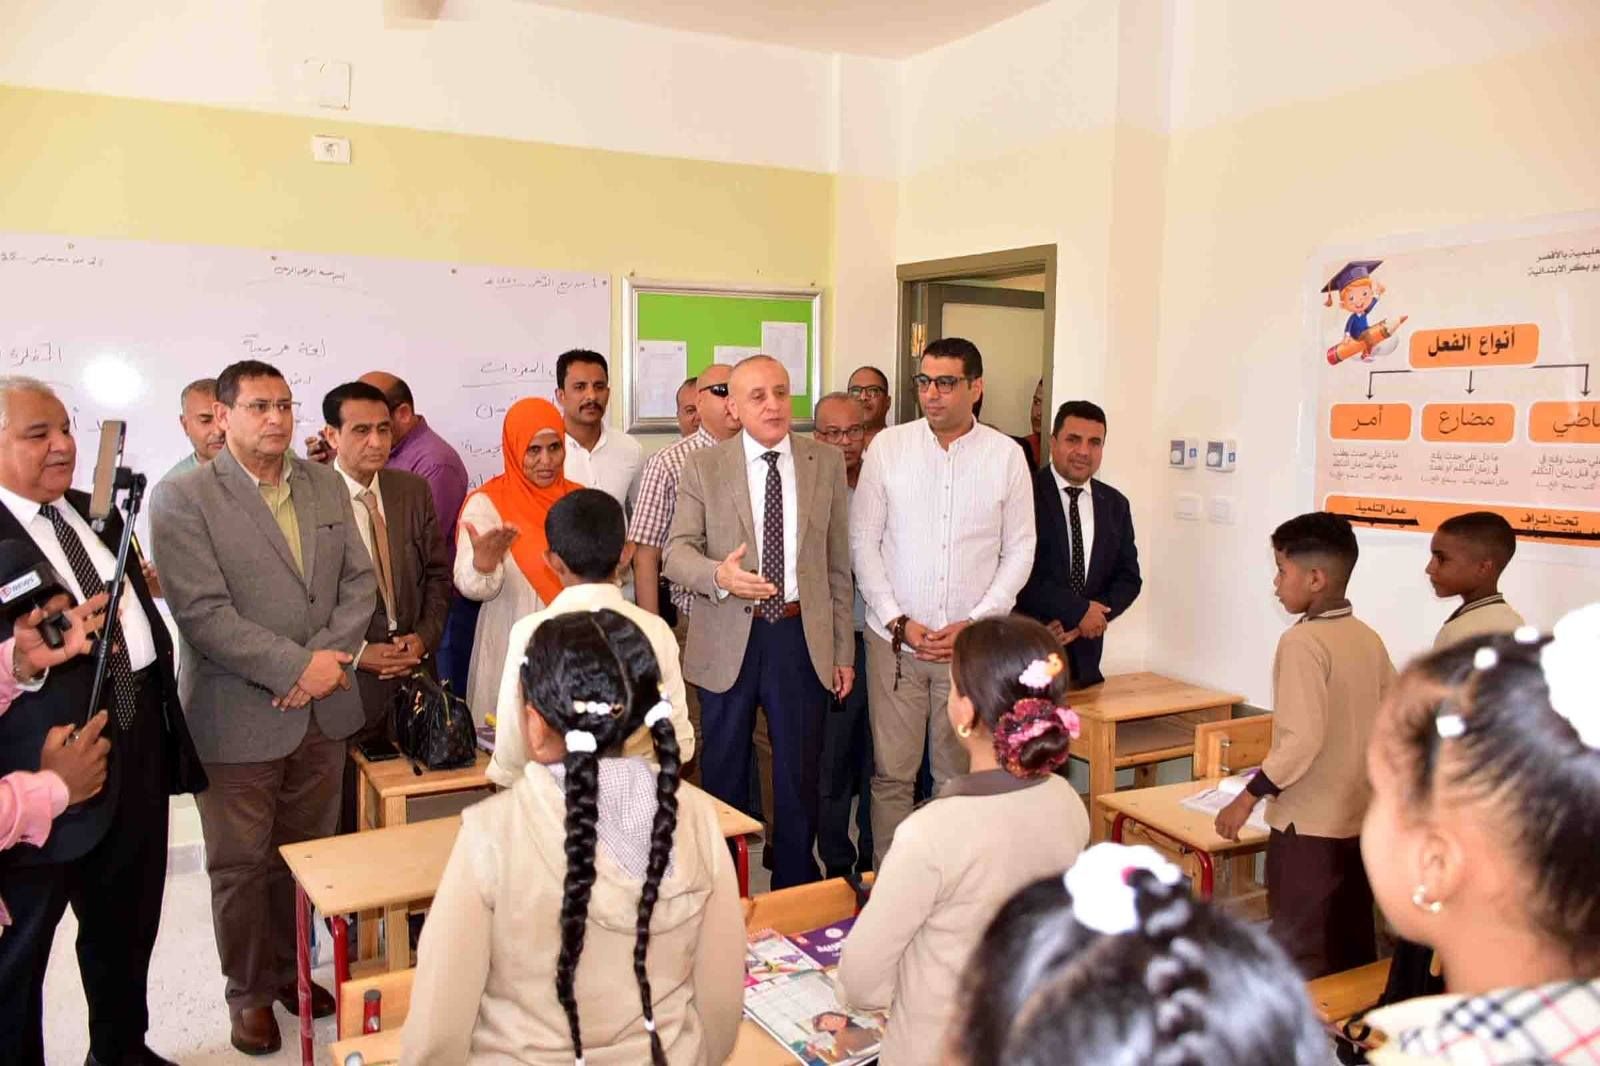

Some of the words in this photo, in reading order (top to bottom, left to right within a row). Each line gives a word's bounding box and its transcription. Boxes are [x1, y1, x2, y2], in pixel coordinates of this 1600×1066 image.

[1428, 334, 1471, 357] الفعل
[1479, 327, 1515, 356] أنواع
[1351, 405, 1383, 431] أمر
[1438, 407, 1495, 434] مضارع
[1386, 504, 1407, 516] عمل
[1553, 515, 1579, 527] تحت
